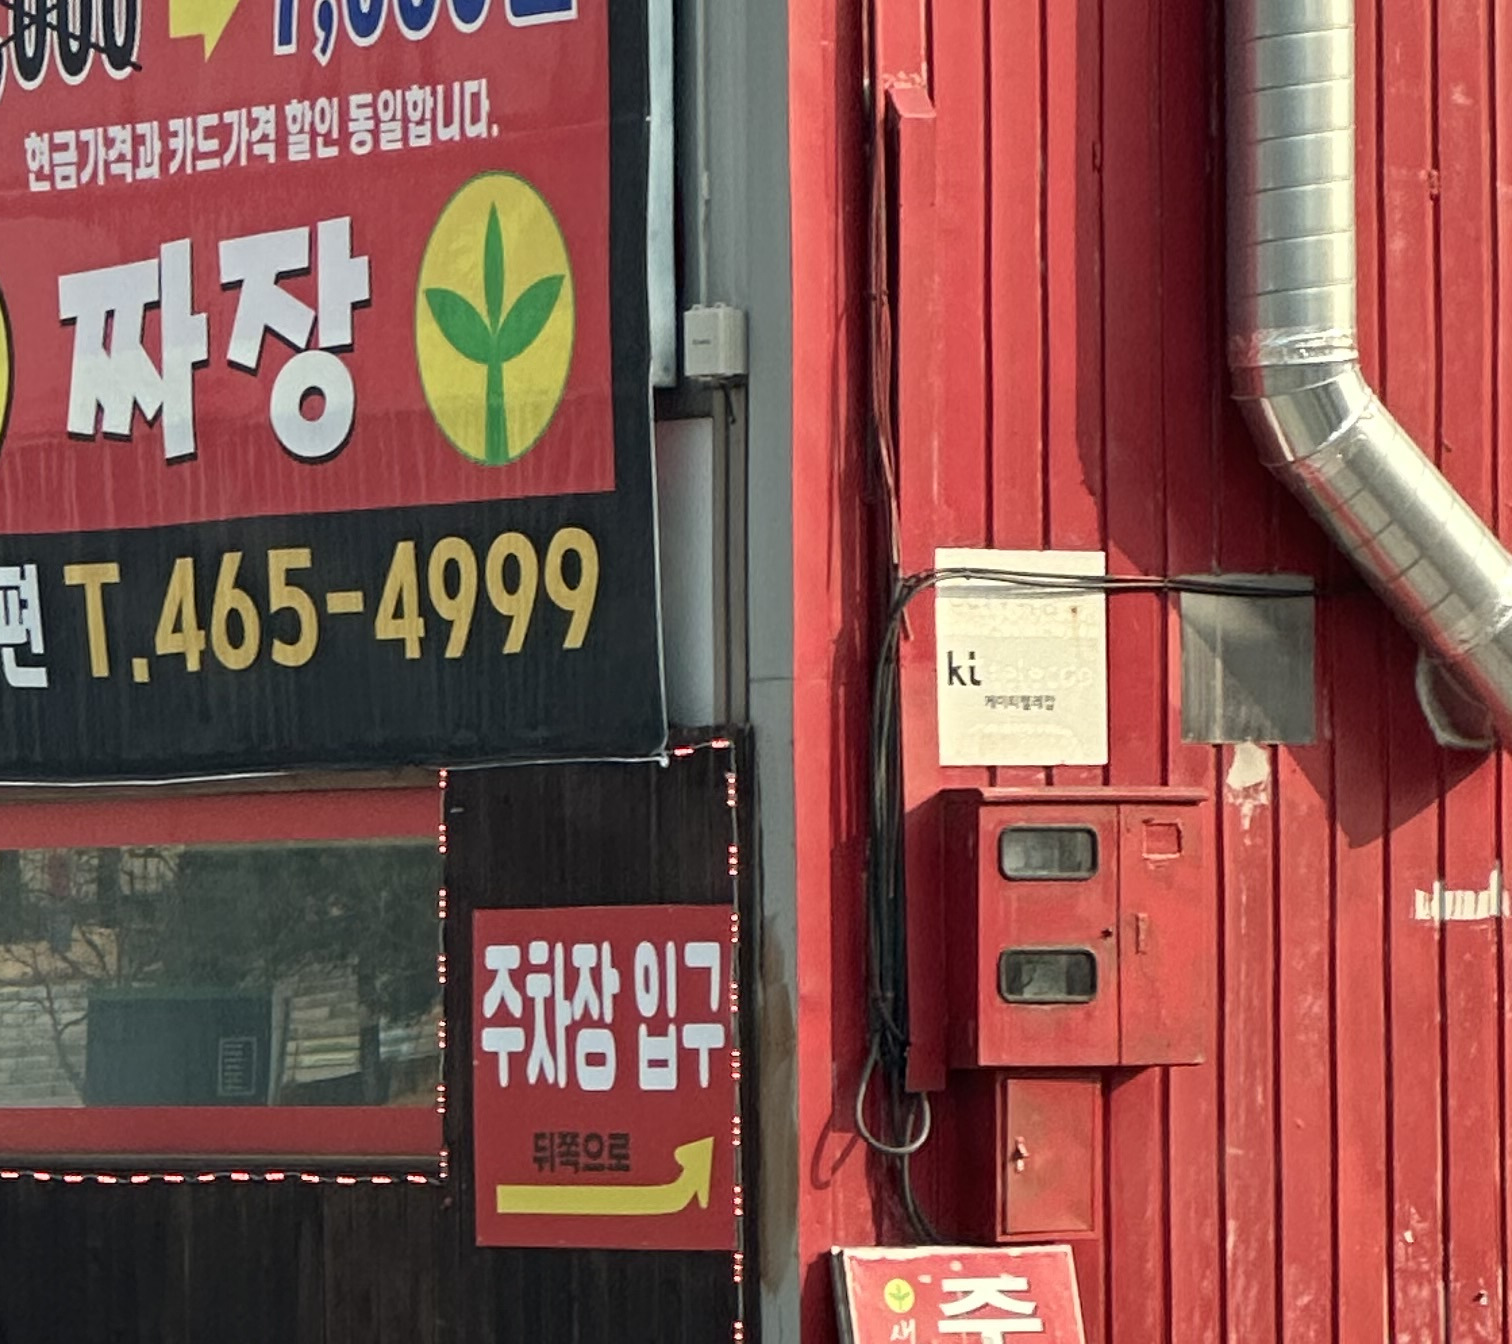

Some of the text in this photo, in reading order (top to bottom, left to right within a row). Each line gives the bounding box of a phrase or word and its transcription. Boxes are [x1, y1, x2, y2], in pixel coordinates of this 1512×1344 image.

[24, 78, 499, 192] 현금가격과 카드가격 할인 동일합니다.
[58, 216, 371, 463] 짜장
[64, 527, 599, 684] T.465-4999
[481, 940, 725, 1091] 주차장 입구
[533, 1132, 631, 1174] 뒤쪽으로
